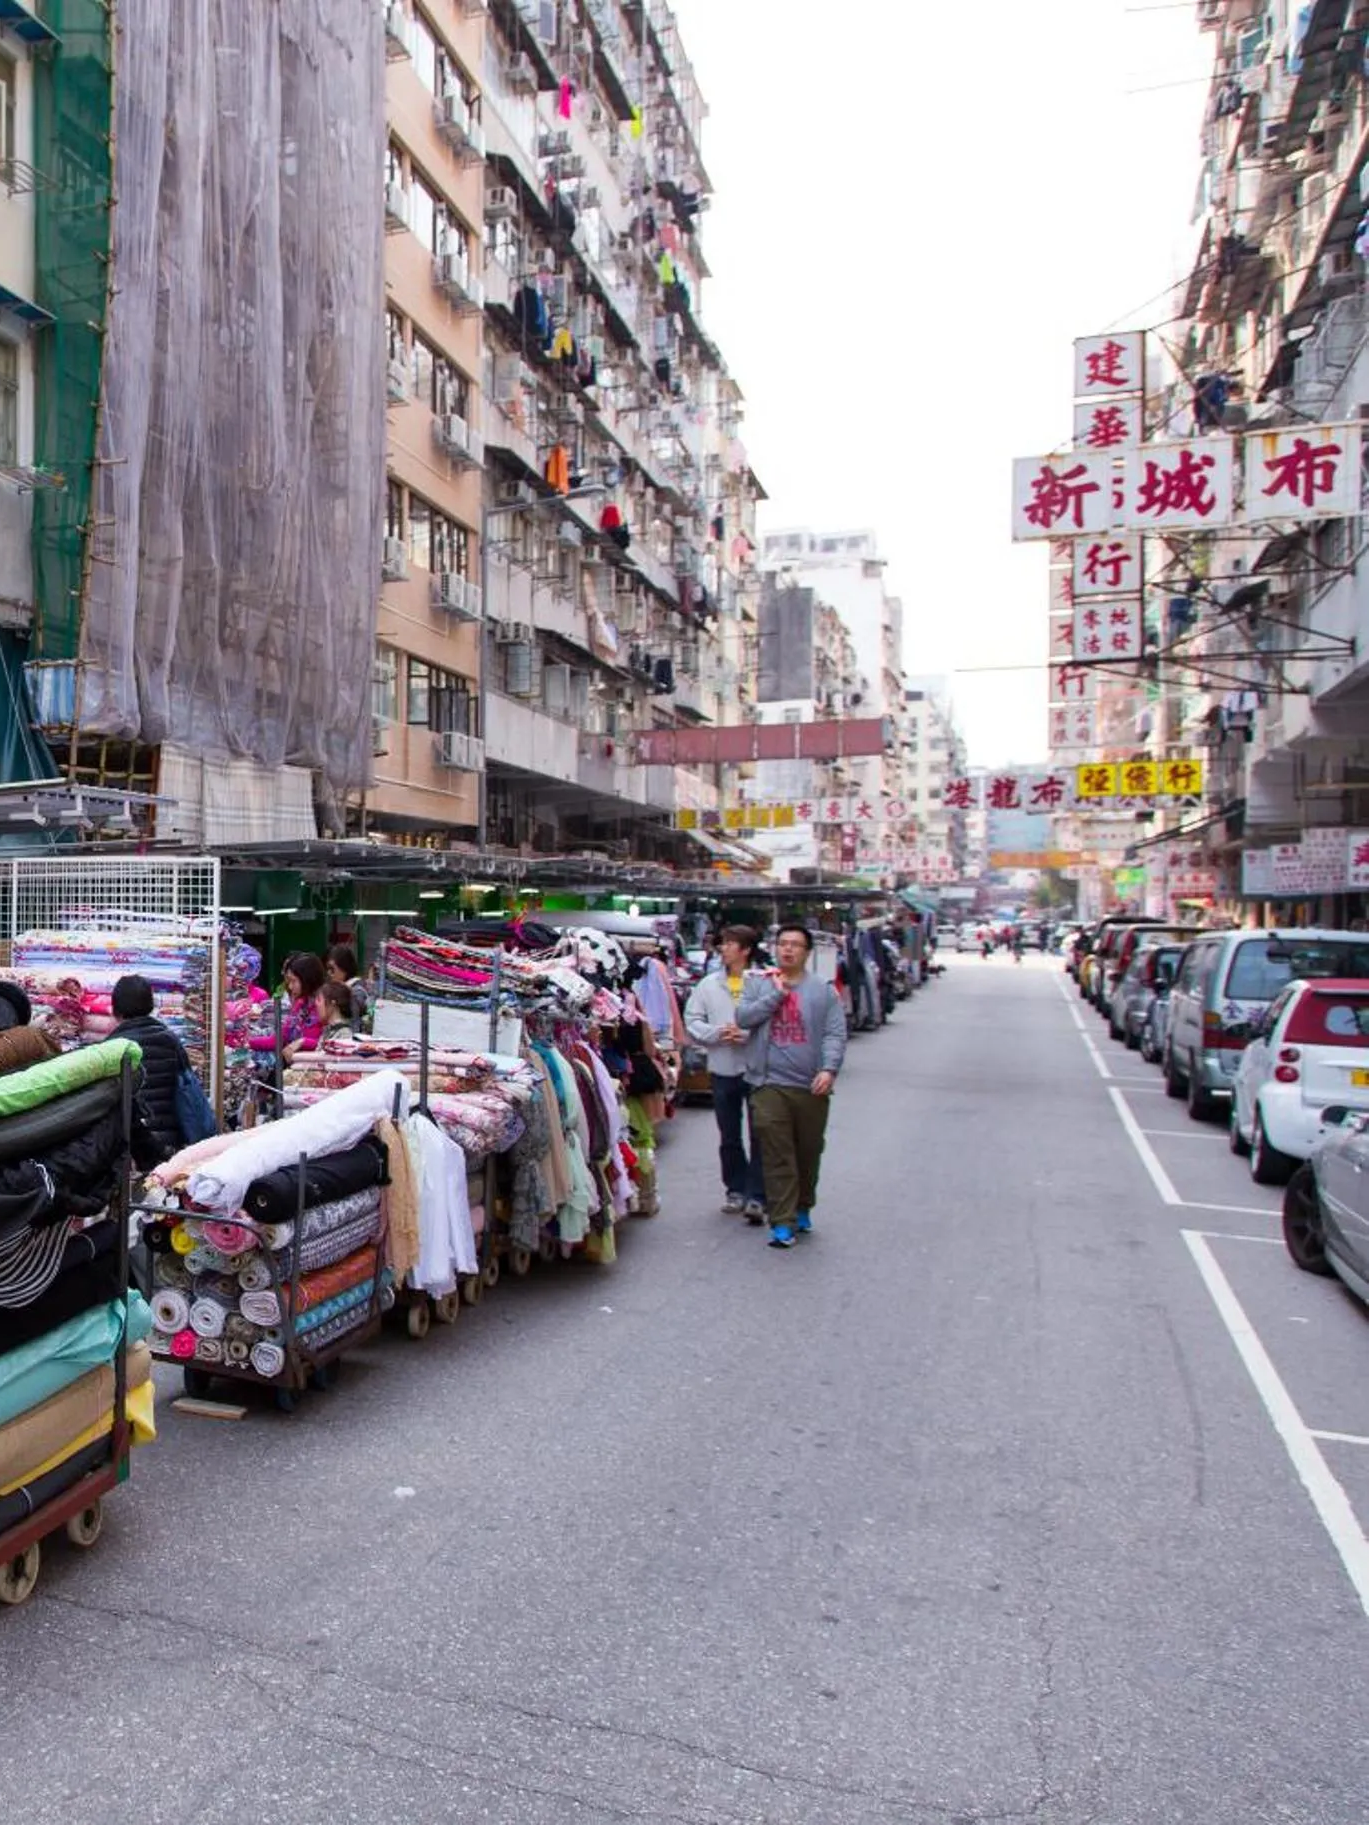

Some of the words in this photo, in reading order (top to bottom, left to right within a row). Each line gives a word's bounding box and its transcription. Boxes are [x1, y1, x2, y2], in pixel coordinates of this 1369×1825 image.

[1022, 437, 1344, 530] 新城布
[1083, 340, 1134, 588] 建華行
